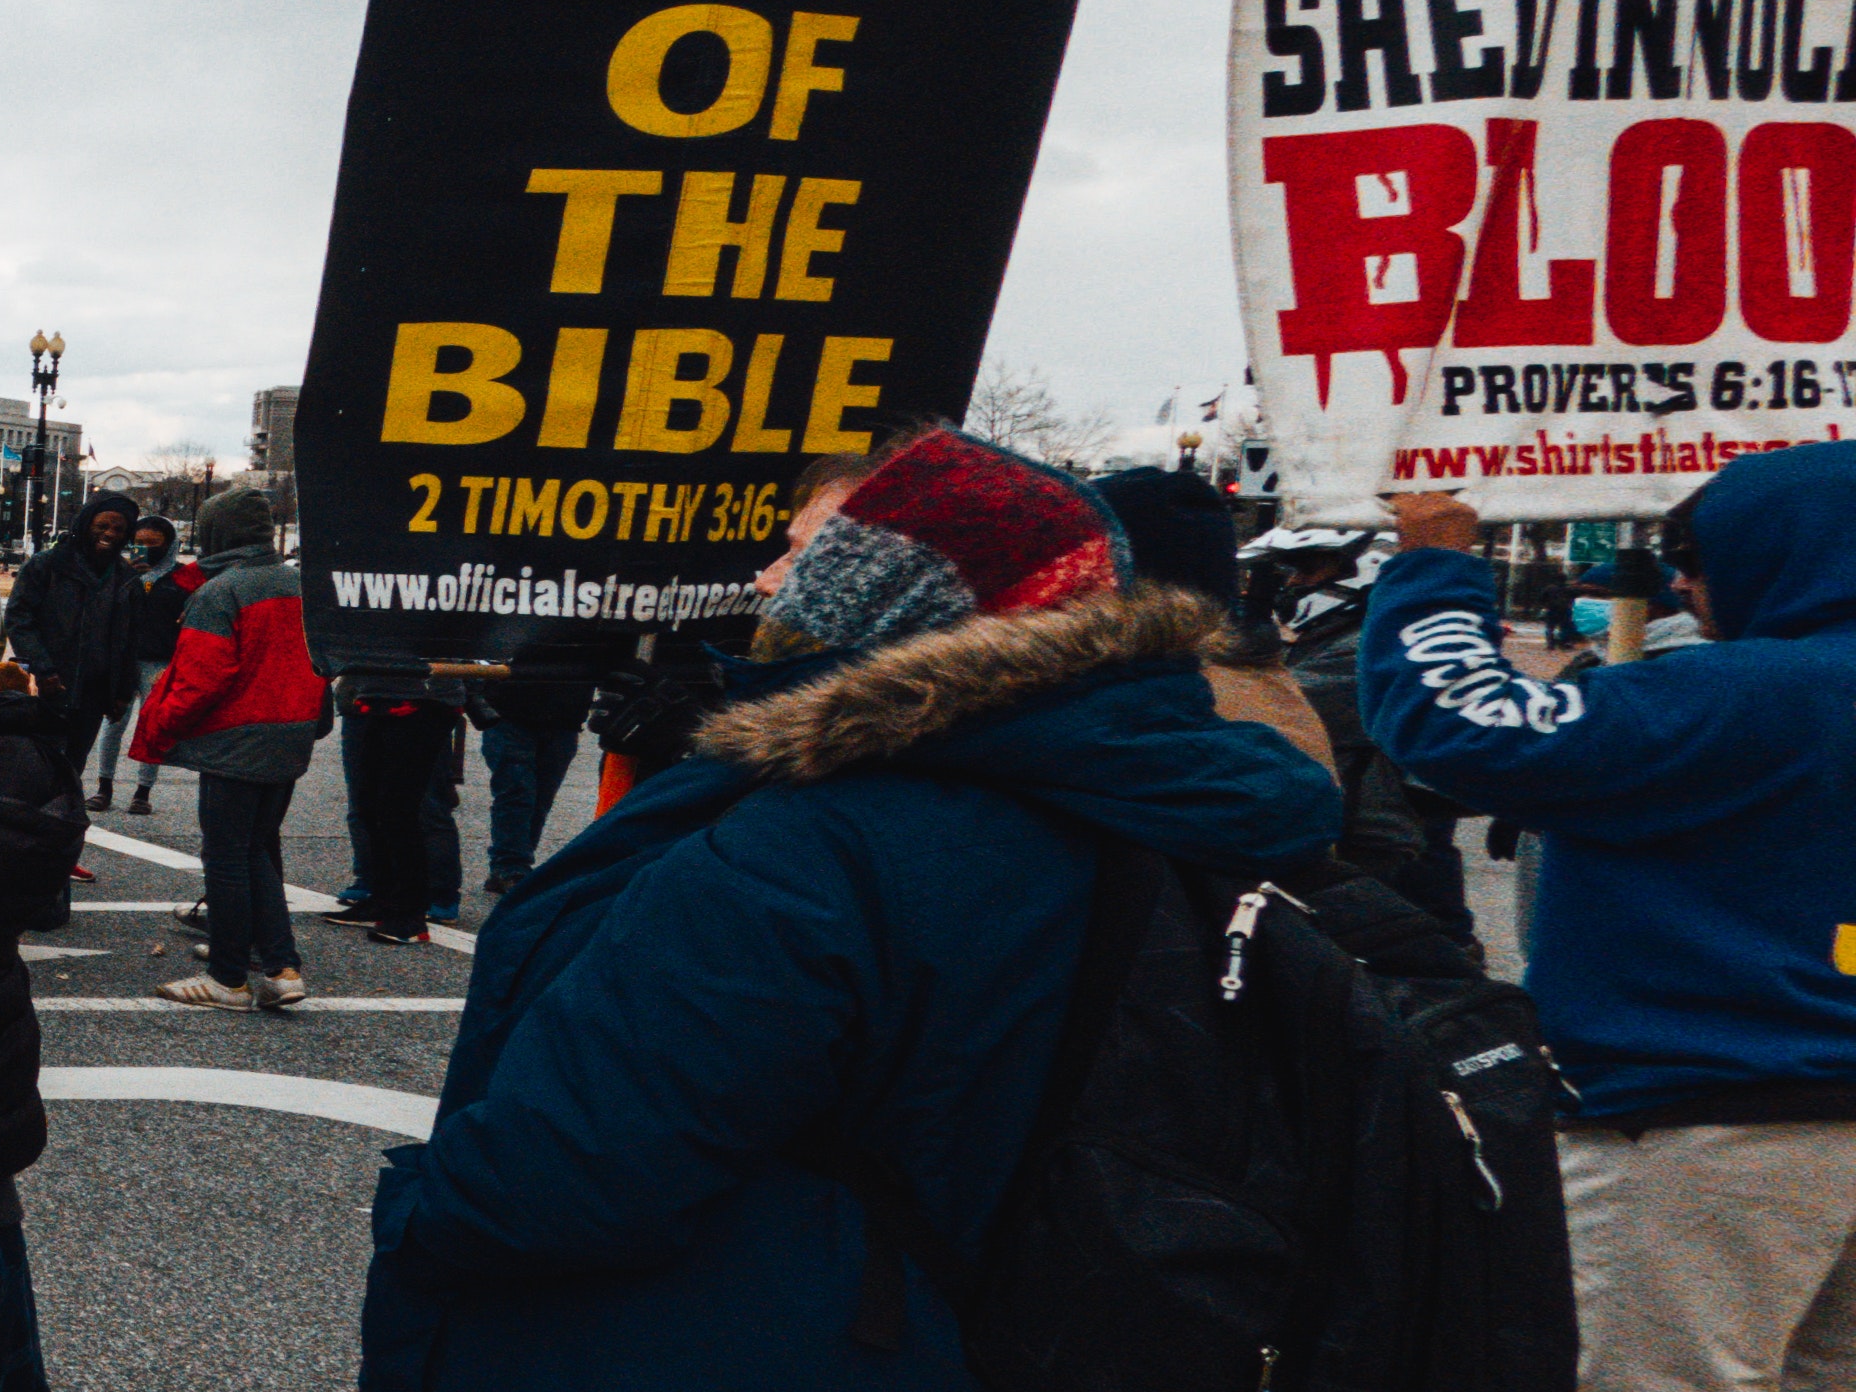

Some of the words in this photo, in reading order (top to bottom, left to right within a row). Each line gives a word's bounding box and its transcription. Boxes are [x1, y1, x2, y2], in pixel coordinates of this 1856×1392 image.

[605, 4, 861, 142] OF
[525, 168, 862, 304] THE
[379, 320, 895, 456] BIBLE
[407, 472, 443, 534] 2
[460, 475, 707, 543] TIMOTHY
